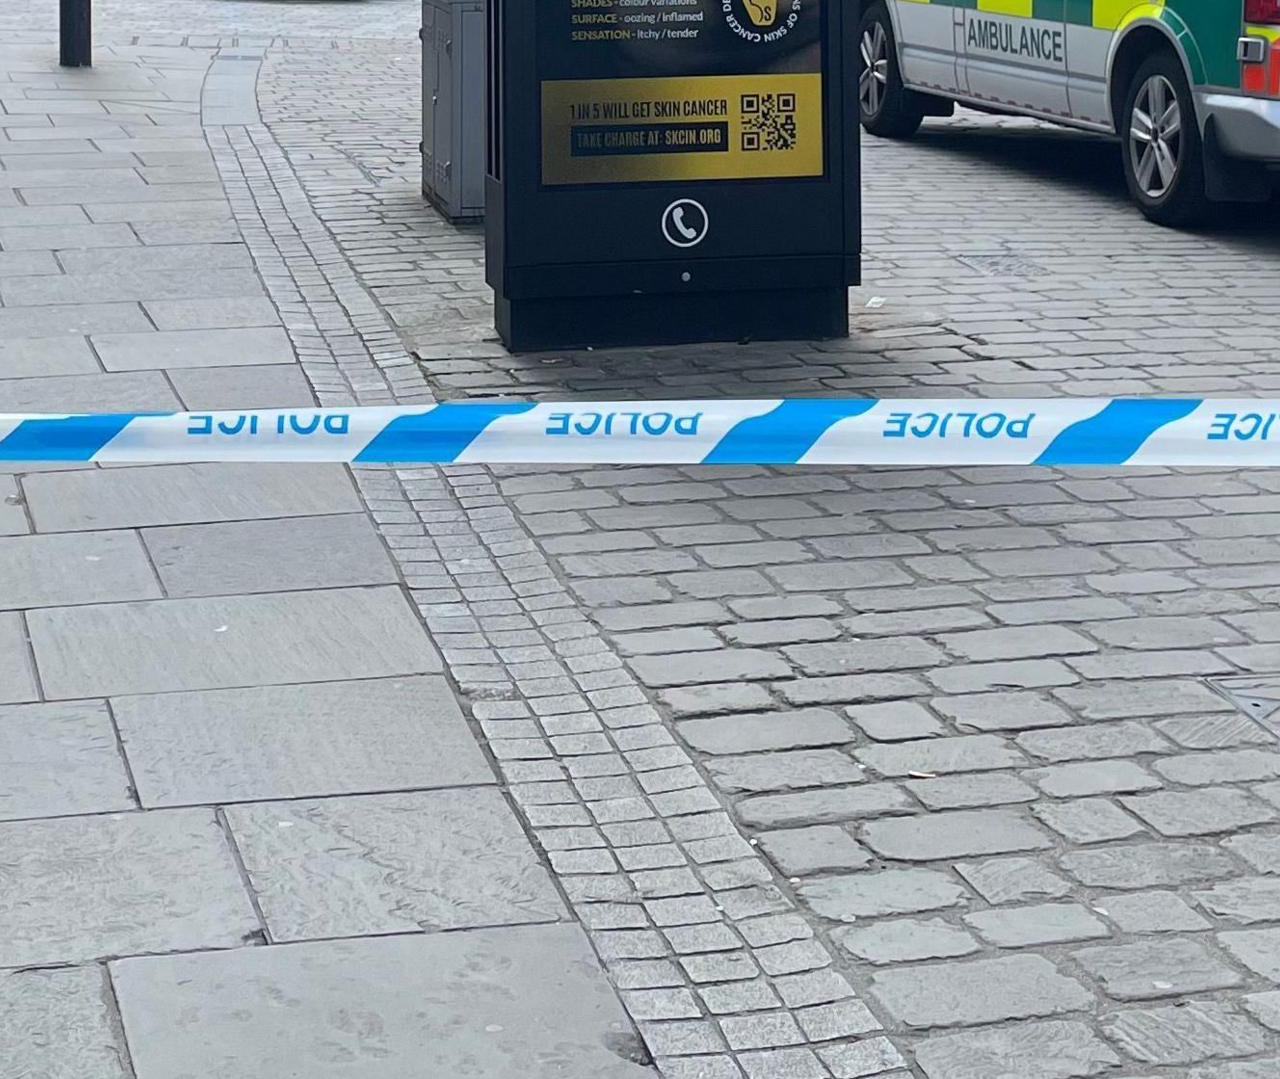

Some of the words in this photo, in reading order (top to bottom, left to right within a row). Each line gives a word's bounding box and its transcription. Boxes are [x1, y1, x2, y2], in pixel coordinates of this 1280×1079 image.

[571, 13, 618, 24] SURFACE
[624, 13, 655, 25] oozing
[725, 13, 761, 42] CANCER
[786, 13, 798, 28] OF
[571, 30, 631, 41] SENSATION
[666, 29, 699, 39] tender
[764, 25, 788, 43] SKIN
[967, 18, 1063, 62] AMBULANCE
[578, 103, 591, 119] IN
[592, 102, 600, 119] 5
[601, 101, 631, 119] WILL
[632, 101, 652, 118] GET
[654, 100, 681, 117] SKIN
[682, 99, 728, 116] CANCER
[577, 133, 602, 148] TAKE
[604, 131, 646, 147] CHARGE
[665, 128, 721, 145] SKCIN.ORG
[544, 412, 703, 436] POLICE
[882, 412, 1037, 439] POLICE
